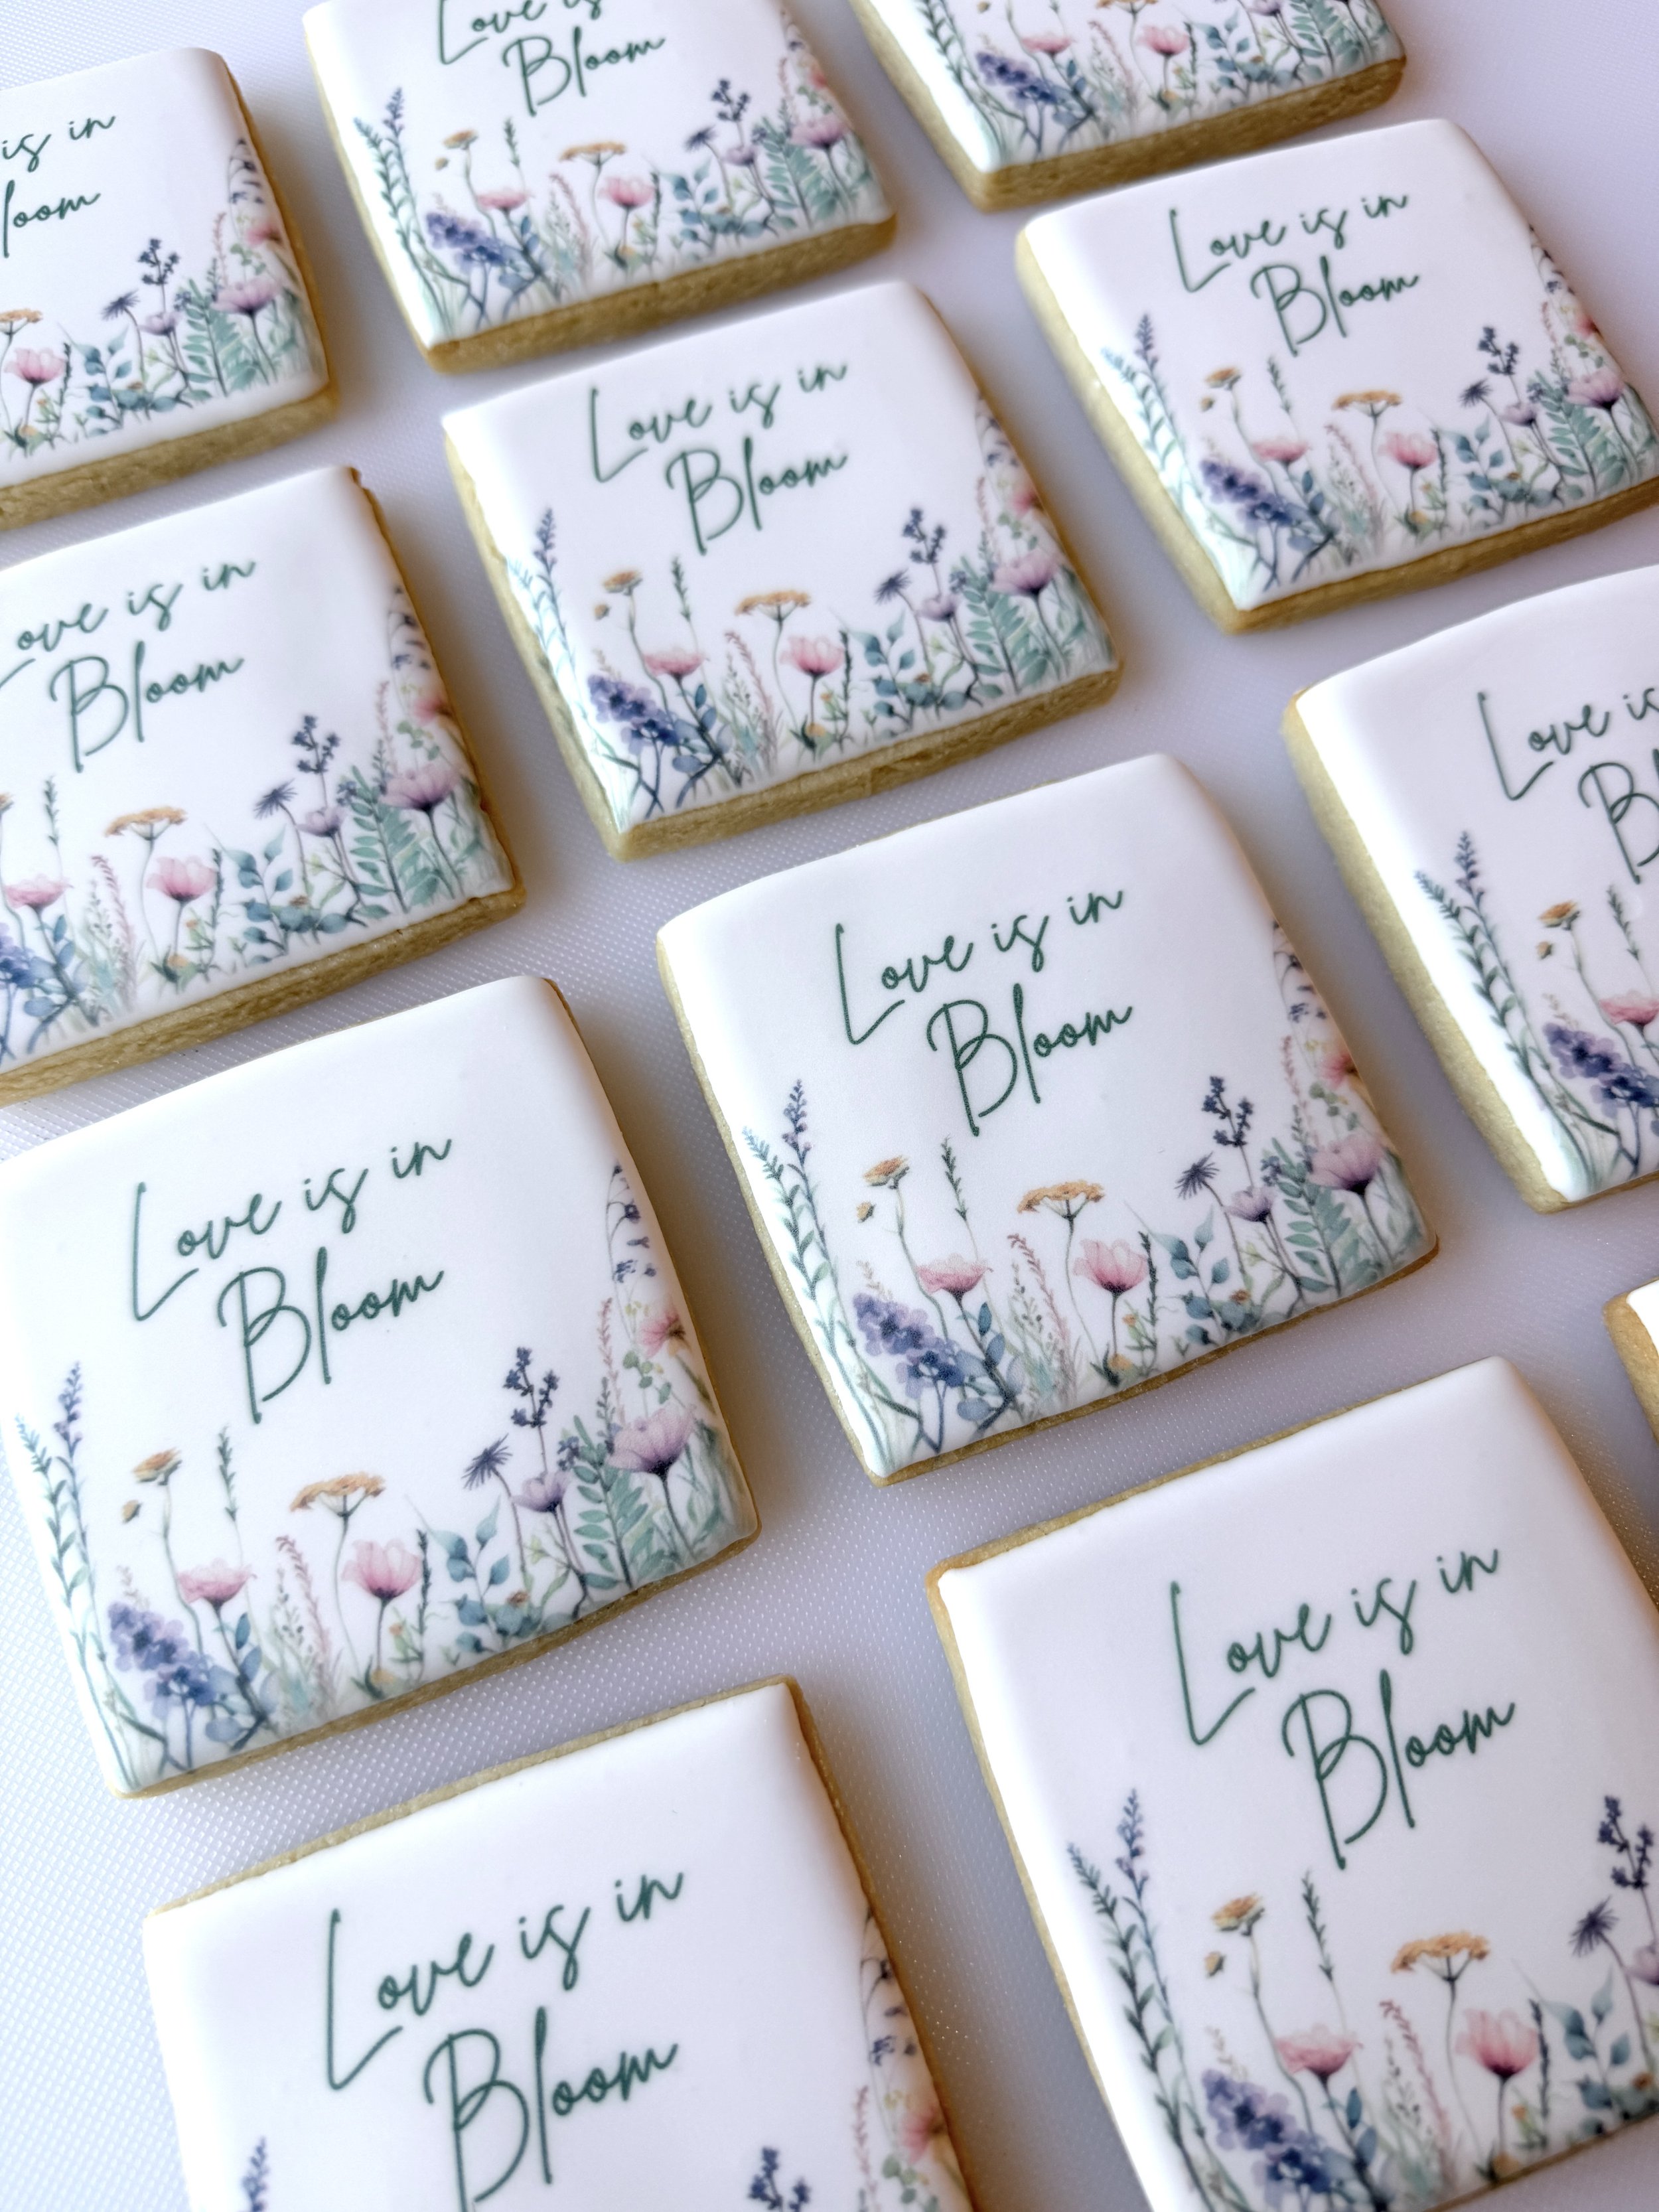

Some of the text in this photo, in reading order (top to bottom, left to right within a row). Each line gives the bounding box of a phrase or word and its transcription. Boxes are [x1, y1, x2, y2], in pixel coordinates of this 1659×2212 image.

[500, 25, 667, 118] Bloom
[2, 115, 117, 173] is in
[0, 179, 102, 259] loom
[1169, 194, 1409, 293] Love is in
[1249, 254, 1421, 358] Bloom
[589, 364, 848, 484] Love is in
[664, 435, 849, 557] Bloom
[0, 561, 256, 690] ove is in
[47, 640, 245, 774] Bloom
[1477, 691, 1611, 802] Love
[833, 890, 1124, 1046] Love is in
[924, 982, 1133, 1138] Bloom
[130, 1138, 453, 1323] Love is in
[215, 1246, 445, 1426] Bloom
[1169, 1548, 1499, 1747] Love is in
[1280, 1668, 1516, 1872] Bloom
[325, 1872, 685, 2093] Love is in
[421, 2005, 680, 2212] Bloom
